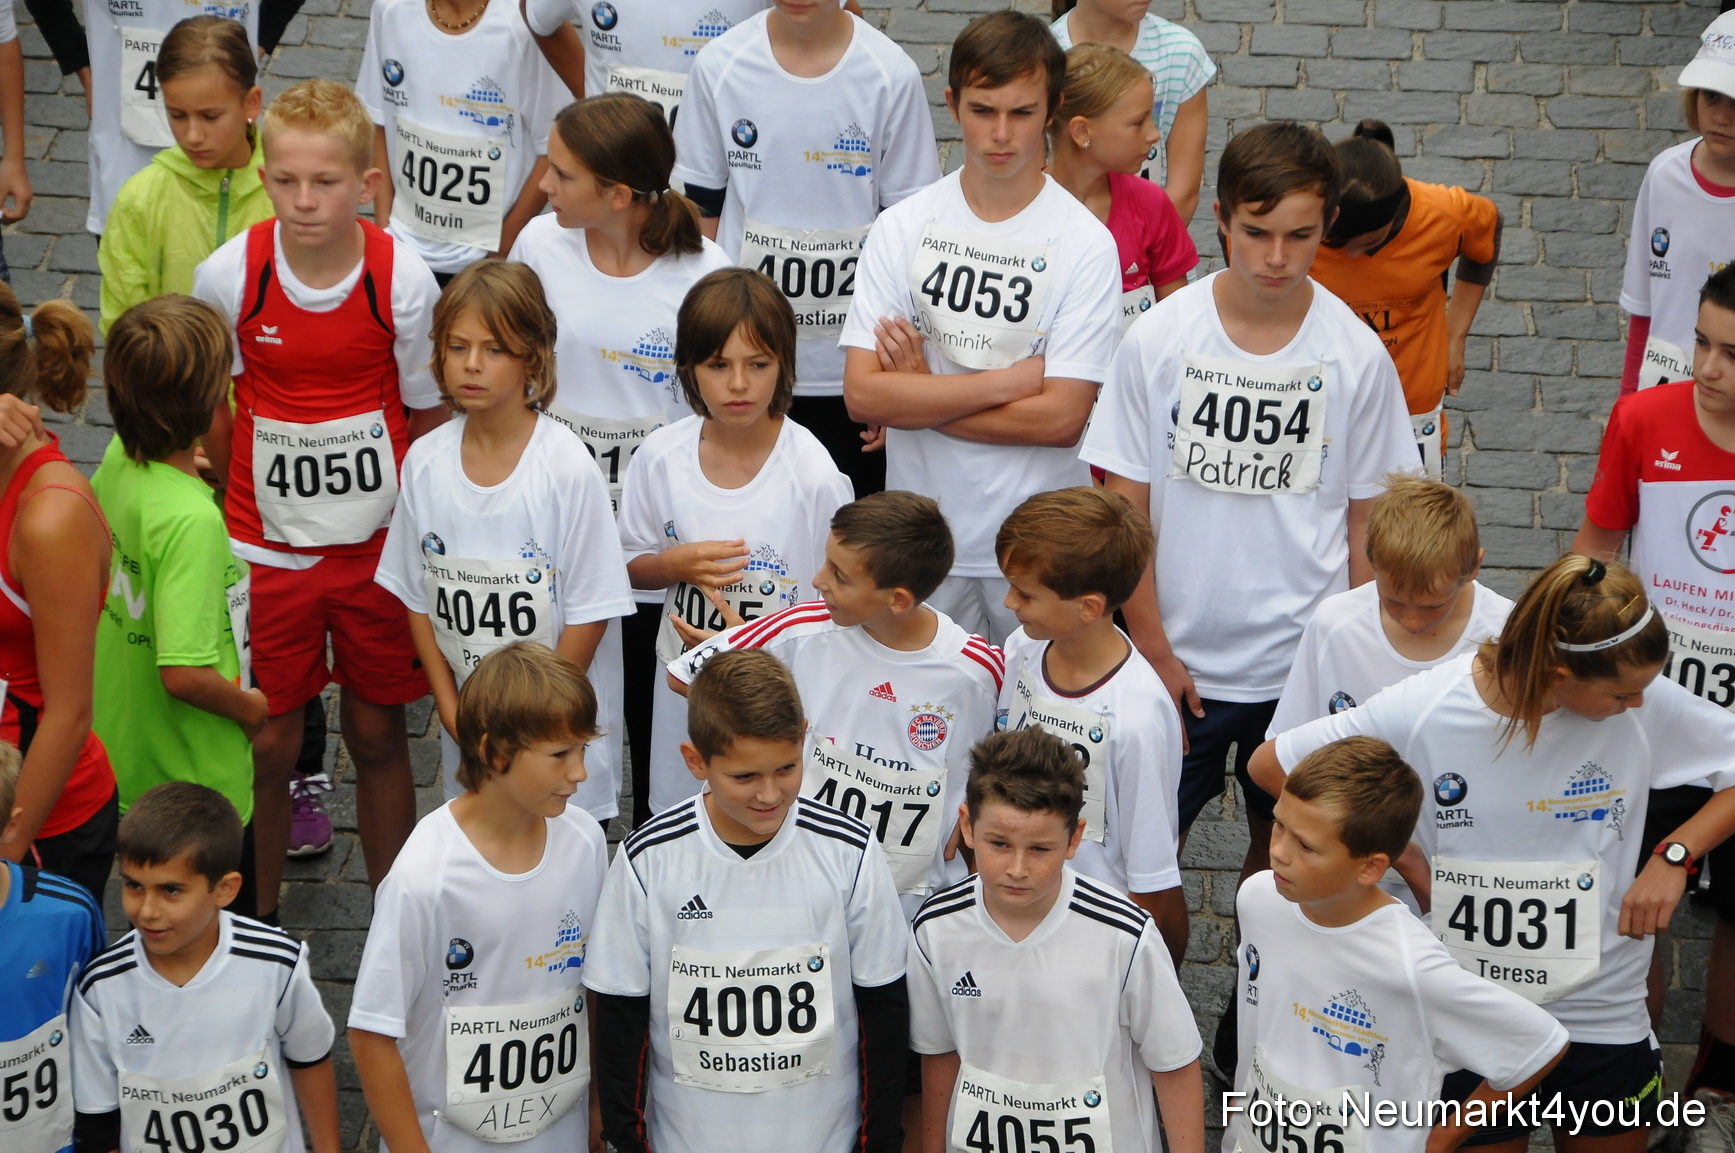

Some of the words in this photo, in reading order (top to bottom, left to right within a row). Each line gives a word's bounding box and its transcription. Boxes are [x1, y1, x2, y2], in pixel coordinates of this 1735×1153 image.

[124, 39, 160, 53] PART
[591, 30, 622, 45] PARTL
[610, 75, 648, 92] PARTL
[651, 84, 683, 97] Neum
[396, 125, 424, 147] PARTL
[425, 141, 482, 159] Neumarkt
[727, 150, 761, 163] PARTL
[728, 161, 762, 170] Neumarkt
[402, 149, 491, 206] 4025
[414, 202, 463, 229] Marvin
[745, 231, 787, 250] PARTL
[790, 239, 853, 252] Neumarkt
[921, 236, 962, 256] PARTL
[964, 246, 1026, 269] Neumarkt
[757, 254, 859, 299] 4002
[921, 260, 1033, 323] 4053
[796, 308, 847, 326] astian
[255, 335, 283, 345] erima
[921, 310, 993, 351] Dominik
[1646, 350, 1680, 373] PARTL
[1186, 367, 1232, 386] PARTL
[1236, 375, 1302, 392] Neumarkt
[1192, 391, 1311, 445] 4054
[256, 430, 296, 447] PARTL
[298, 430, 365, 448] Neumarkt
[580, 425, 646, 440] Neumarkt
[266, 446, 382, 498] 4050
[1186, 441, 1293, 490] Patrick
[1654, 459, 1682, 471] erima
[427, 561, 455, 581] PARTL
[457, 569, 520, 585] Neumarkt
[1653, 573, 1708, 598] LAUFEN
[1714, 588, 1735, 602] MI
[230, 591, 248, 612] PAR
[436, 586, 537, 638] 4046
[1665, 596, 1680, 608] Dr.
[1681, 601, 1708, 615] Heck
[1718, 608, 1735, 619] Dr.
[1690, 639, 1735, 657] Neuma
[869, 689, 897, 702] adidas
[1016, 679, 1032, 703] PAR
[912, 718, 922, 728] FC
[923, 715, 946, 734] BAYERN
[855, 742, 917, 771] Hom
[813, 747, 852, 777] PARTL
[855, 768, 922, 796] Neumarkt
[813, 777, 930, 847] 4017
[1436, 808, 1474, 821] ARTL
[1526, 799, 1552, 813] 14.
[1437, 819, 1474, 830] umarkt
[1435, 870, 1488, 889] PARTL
[1493, 876, 1571, 890] Neumarkt
[677, 910, 714, 921] adidas
[1448, 894, 1577, 950] 4031
[672, 960, 721, 979] PARTL
[725, 962, 802, 979] Neumarkt
[1477, 958, 1547, 985] Teresa
[951, 985, 982, 998] adidas
[451, 1021, 505, 1035] PARTL
[509, 1006, 571, 1033] Neumarkt
[683, 980, 817, 1038] 4008
[126, 1036, 155, 1045] adidas
[0, 1042, 45, 1070] umarkt
[463, 1022, 578, 1094] 4060
[699, 1050, 802, 1073] Sebastian
[3, 1057, 58, 1122] 59
[122, 1086, 169, 1104] PARTL
[172, 1073, 248, 1105] Neumarkt
[962, 1080, 1000, 1105] PARTL
[1003, 1094, 1077, 1111] Neumarkt
[144, 1088, 269, 1153] 4030
[476, 1093, 559, 1131] ALEX
[966, 1109, 1096, 1153] 4055
